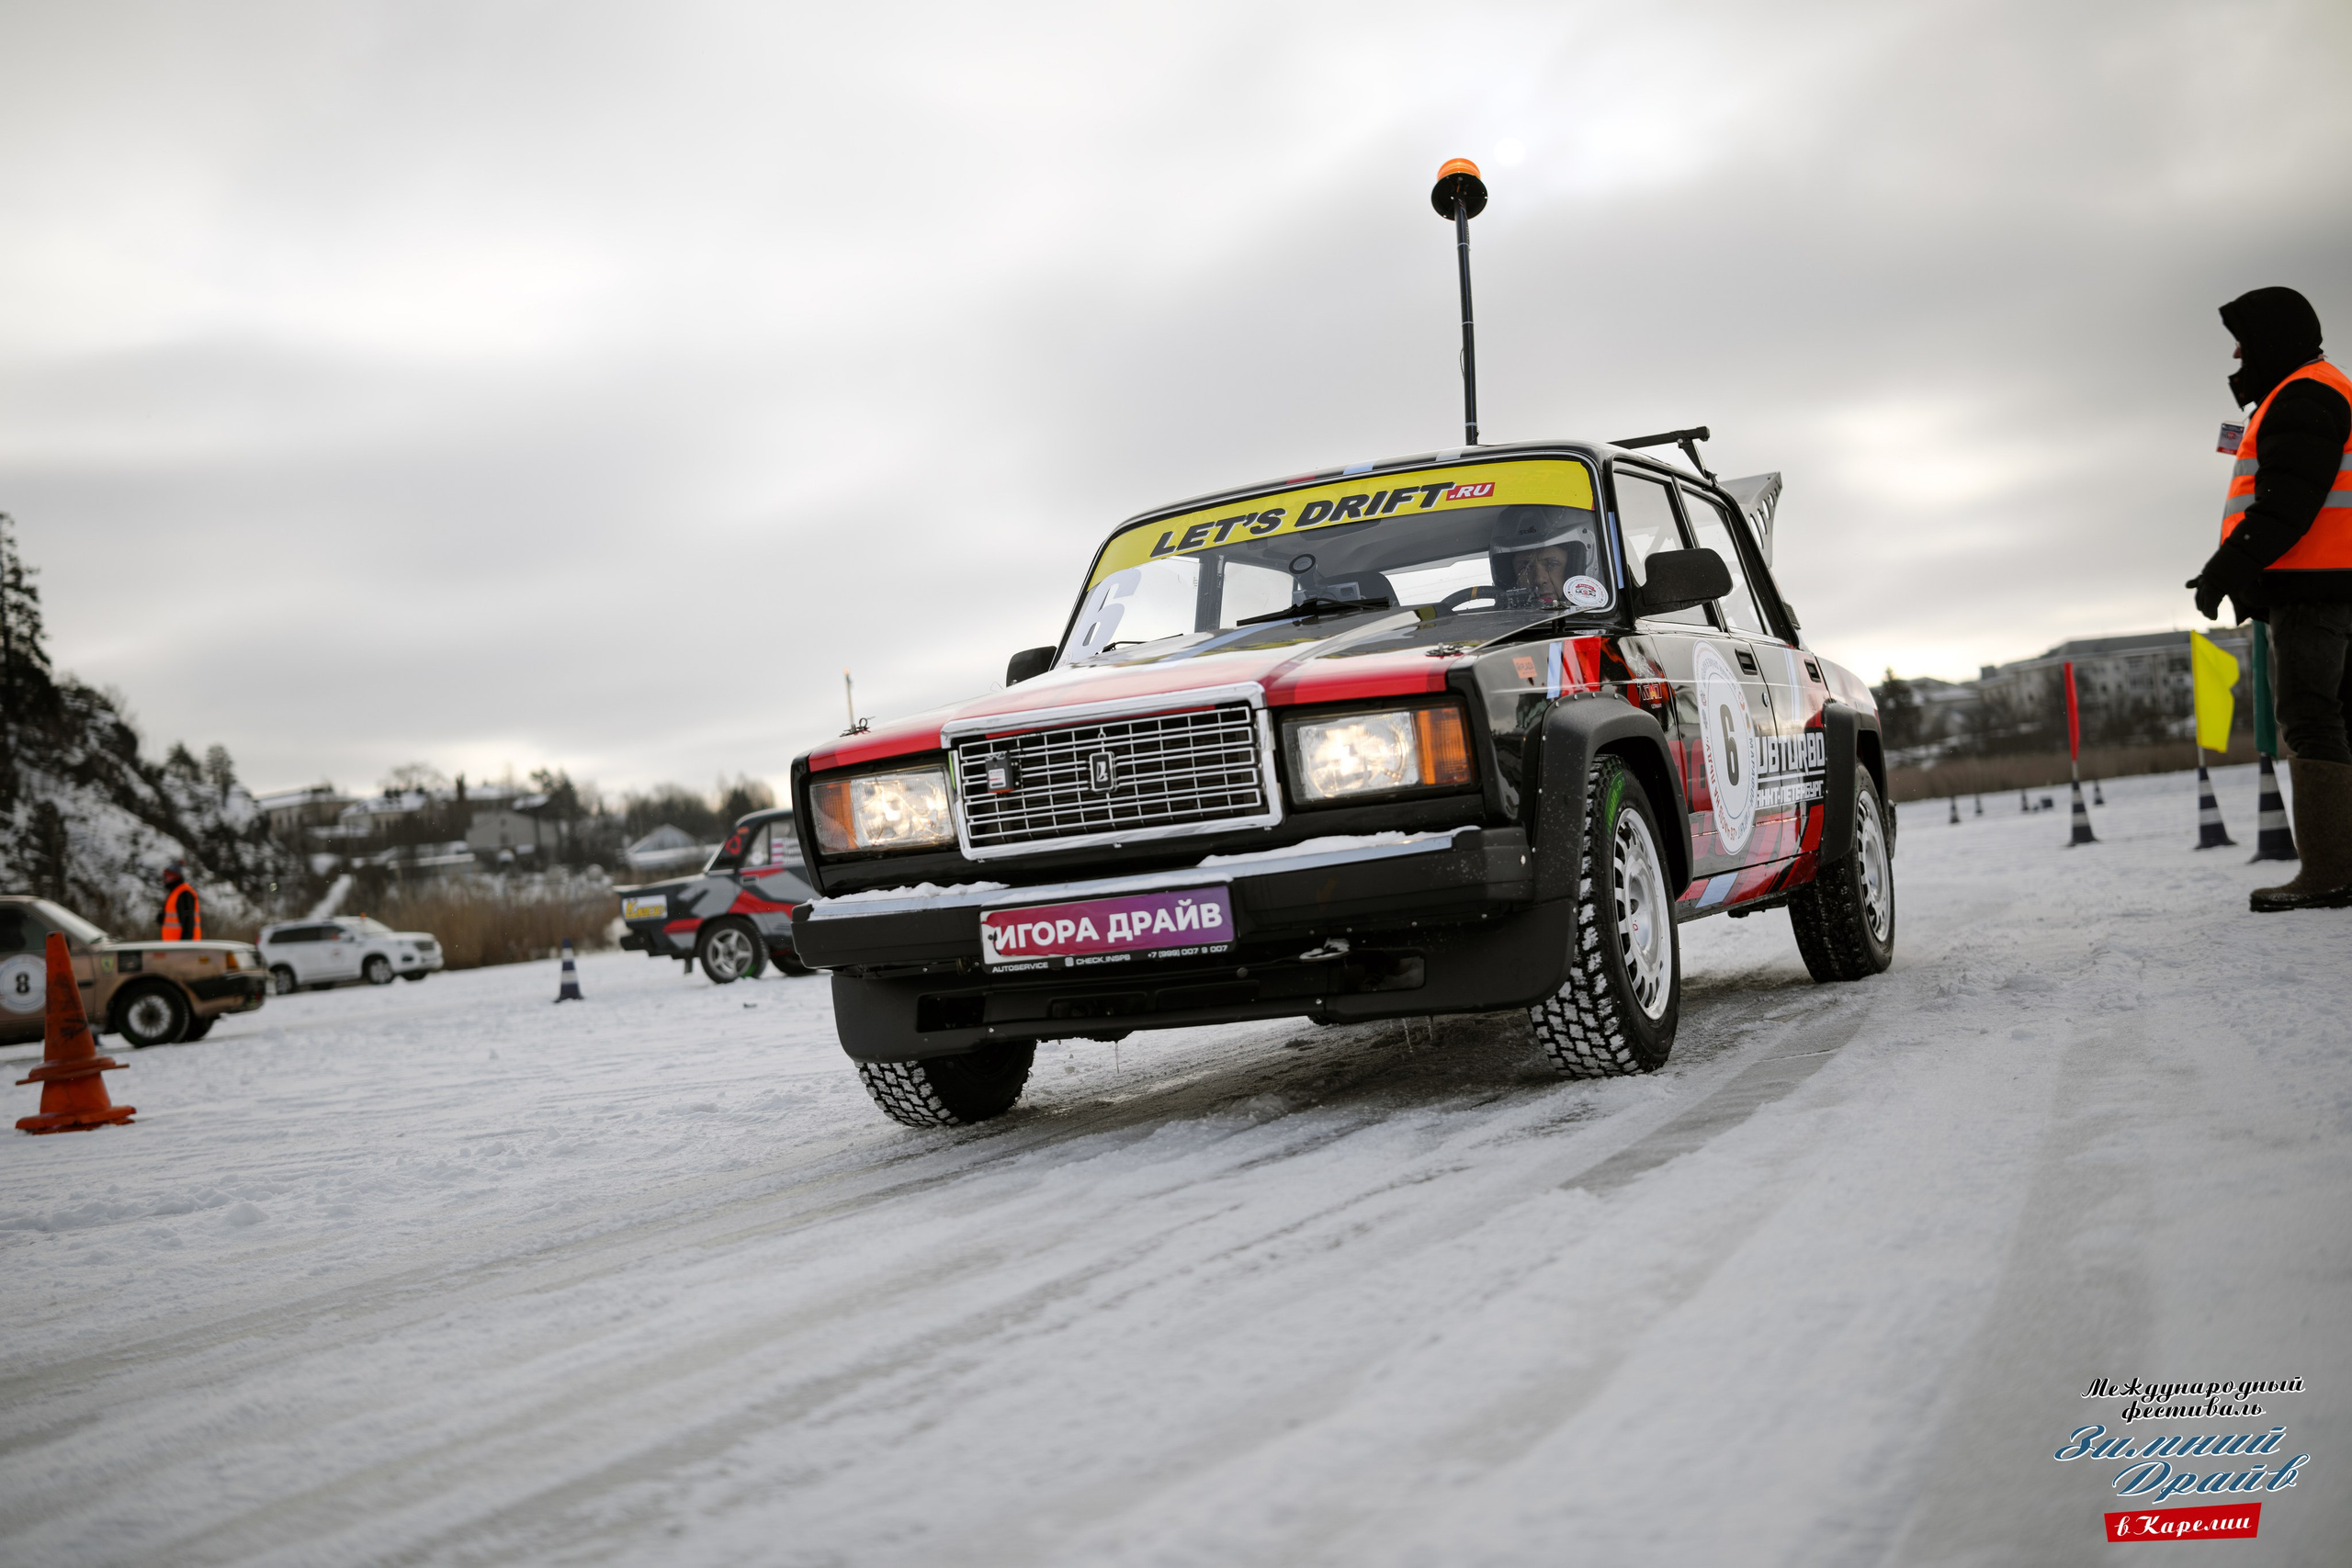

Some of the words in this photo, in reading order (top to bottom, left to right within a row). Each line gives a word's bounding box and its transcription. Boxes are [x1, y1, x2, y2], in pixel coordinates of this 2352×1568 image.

[1149, 507, 1287, 558] LET'S
[1069, 569, 1142, 662] 6
[1719, 704, 1740, 786] 6
[1755, 732, 1826, 775] UBTURBO
[1756, 780, 1824, 807] АНКТ-ПЕТЕРБУРГ
[995, 917, 1100, 950] ИГОРА
[1107, 898, 1223, 943] ДРАЙВ
[992, 962, 1049, 973] AUTOSERVICE
[1182, 947, 1199, 955] 007
[1210, 944, 1228, 953] 007
[16, 971, 30, 994] 8
